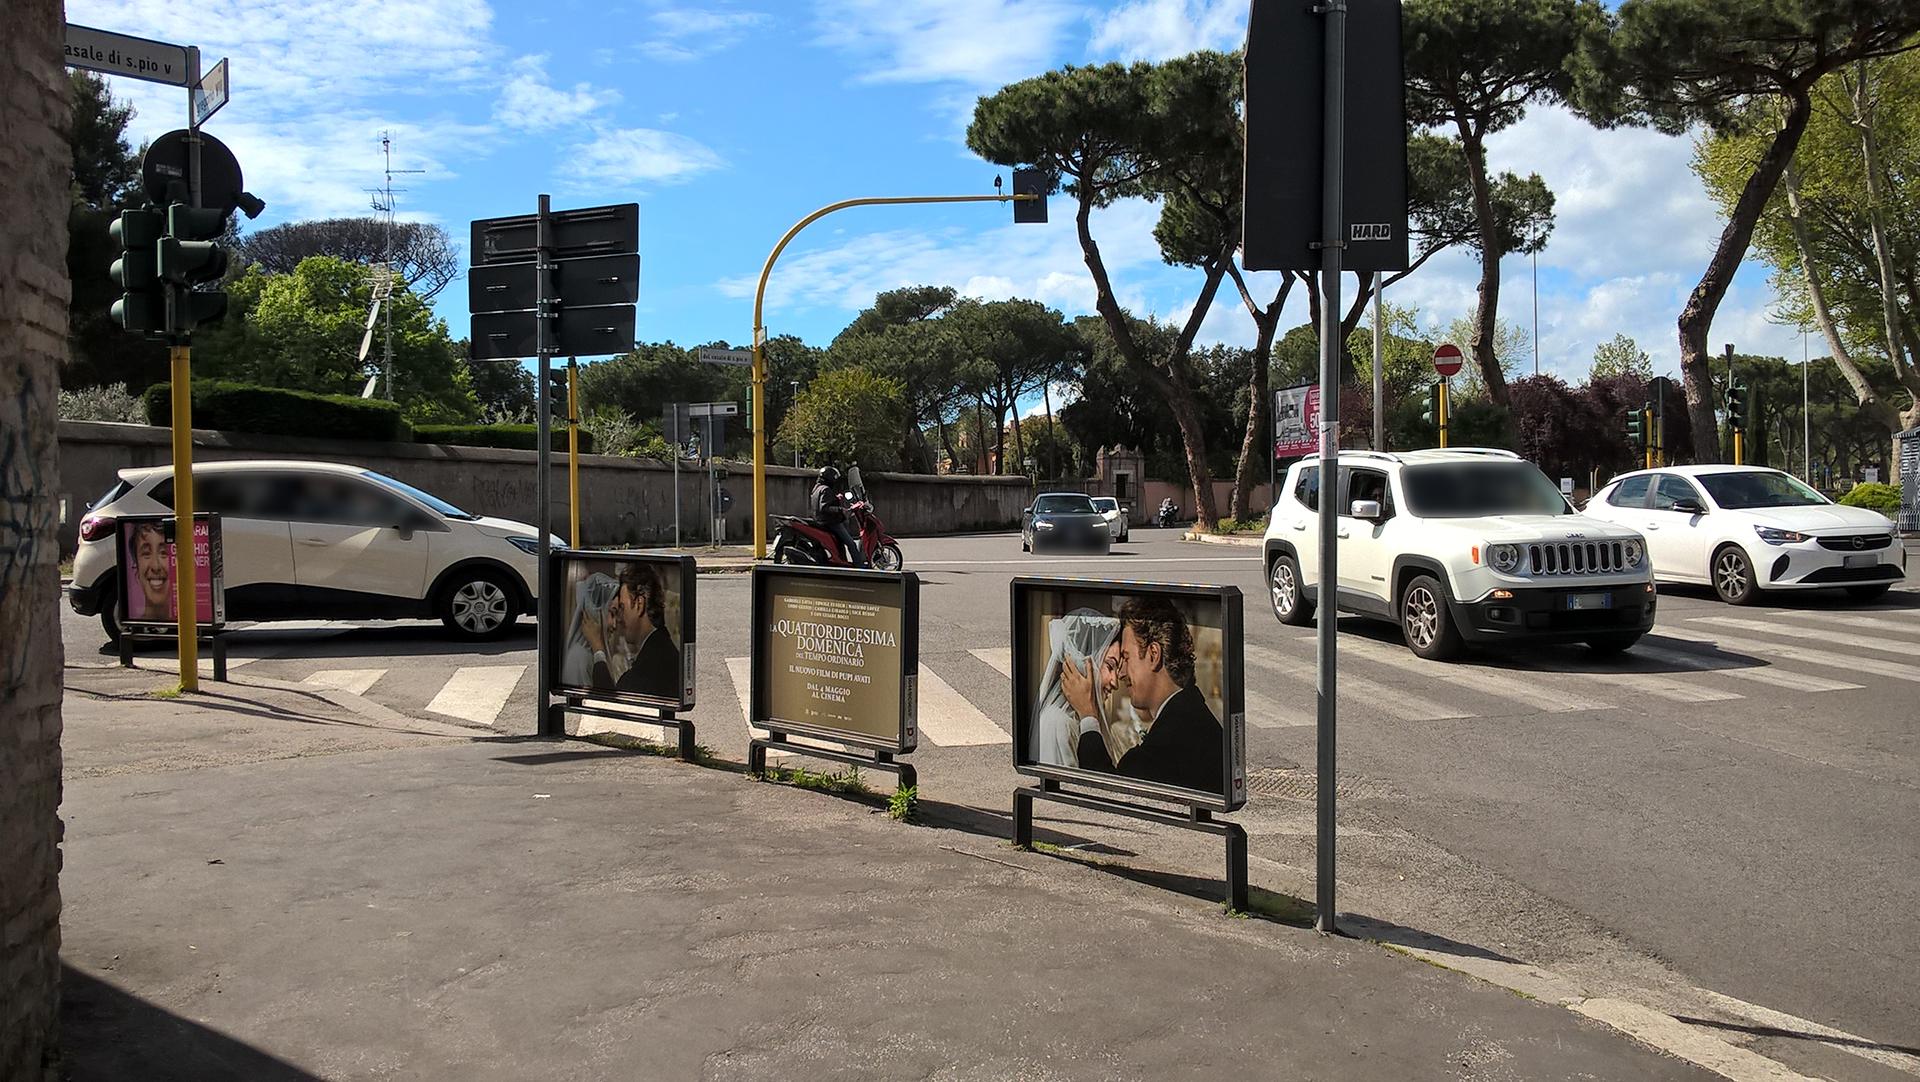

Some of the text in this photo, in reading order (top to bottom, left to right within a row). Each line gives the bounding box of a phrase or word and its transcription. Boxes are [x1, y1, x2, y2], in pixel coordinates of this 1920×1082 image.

[64, 45, 171, 74] asale di s.pio v
[1352, 225, 1390, 239] HARD
[778, 619, 896, 647] QUATTORDICESIMA
[797, 635, 864, 658] DOMENICA
[805, 651, 826, 662] TEMPO
[827, 655, 865, 668] ORDINARIO
[789, 665, 871, 684] IL NUOVO FILM DI PUPI AVATI
[807, 682, 819, 691] DAL
[825, 685, 851, 696] MAGGIO
[812, 691, 846, 703] AL CINEMA
